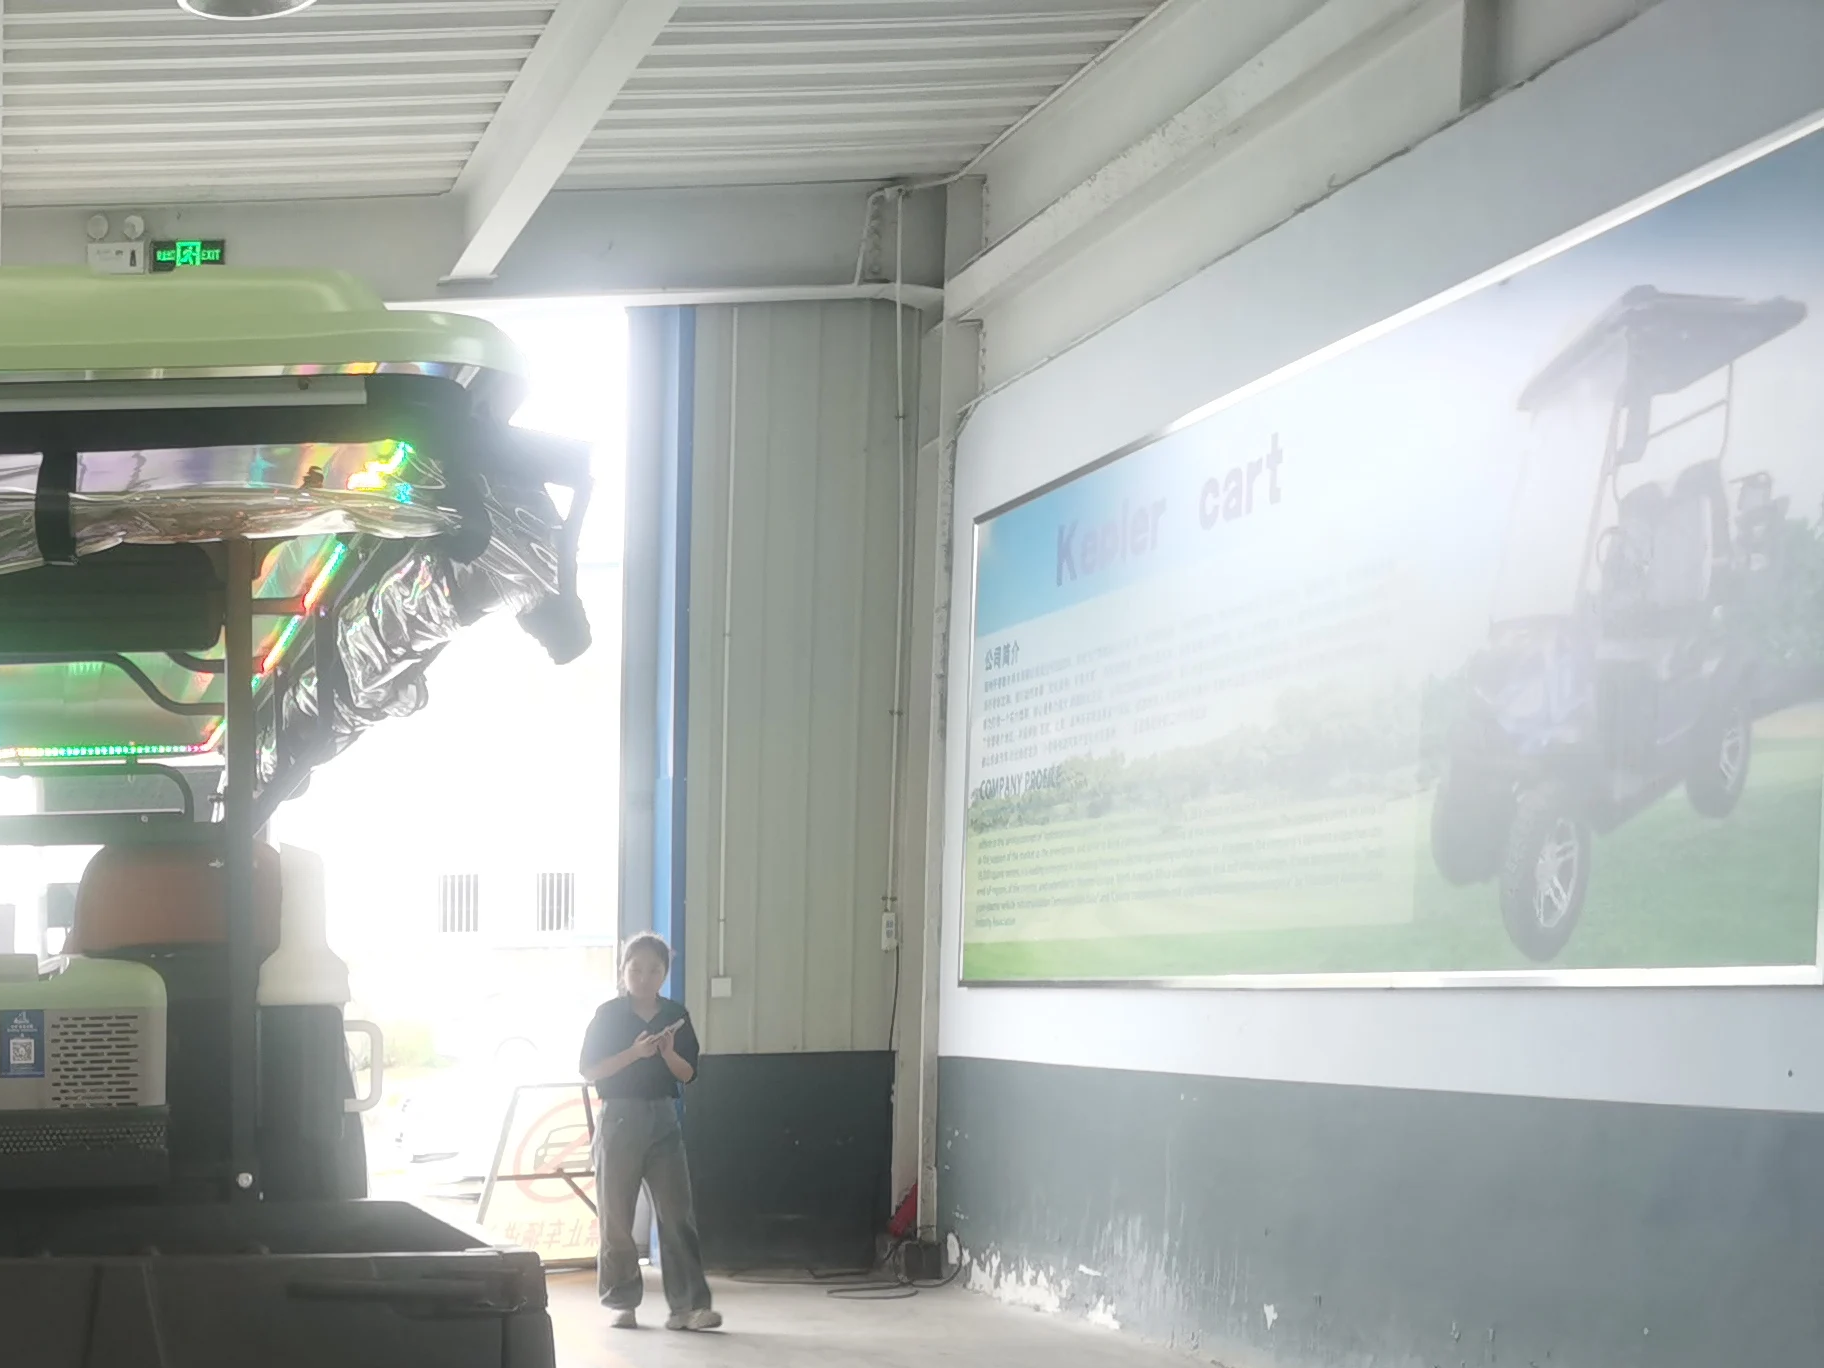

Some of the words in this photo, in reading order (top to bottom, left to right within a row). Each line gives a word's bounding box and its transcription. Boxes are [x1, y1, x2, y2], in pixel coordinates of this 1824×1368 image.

[201, 249, 221, 261] EXIT
[1199, 432, 1283, 531] cart
[984, 640, 1020, 671] 公司简介
[979, 772, 1023, 801] COMPANY
